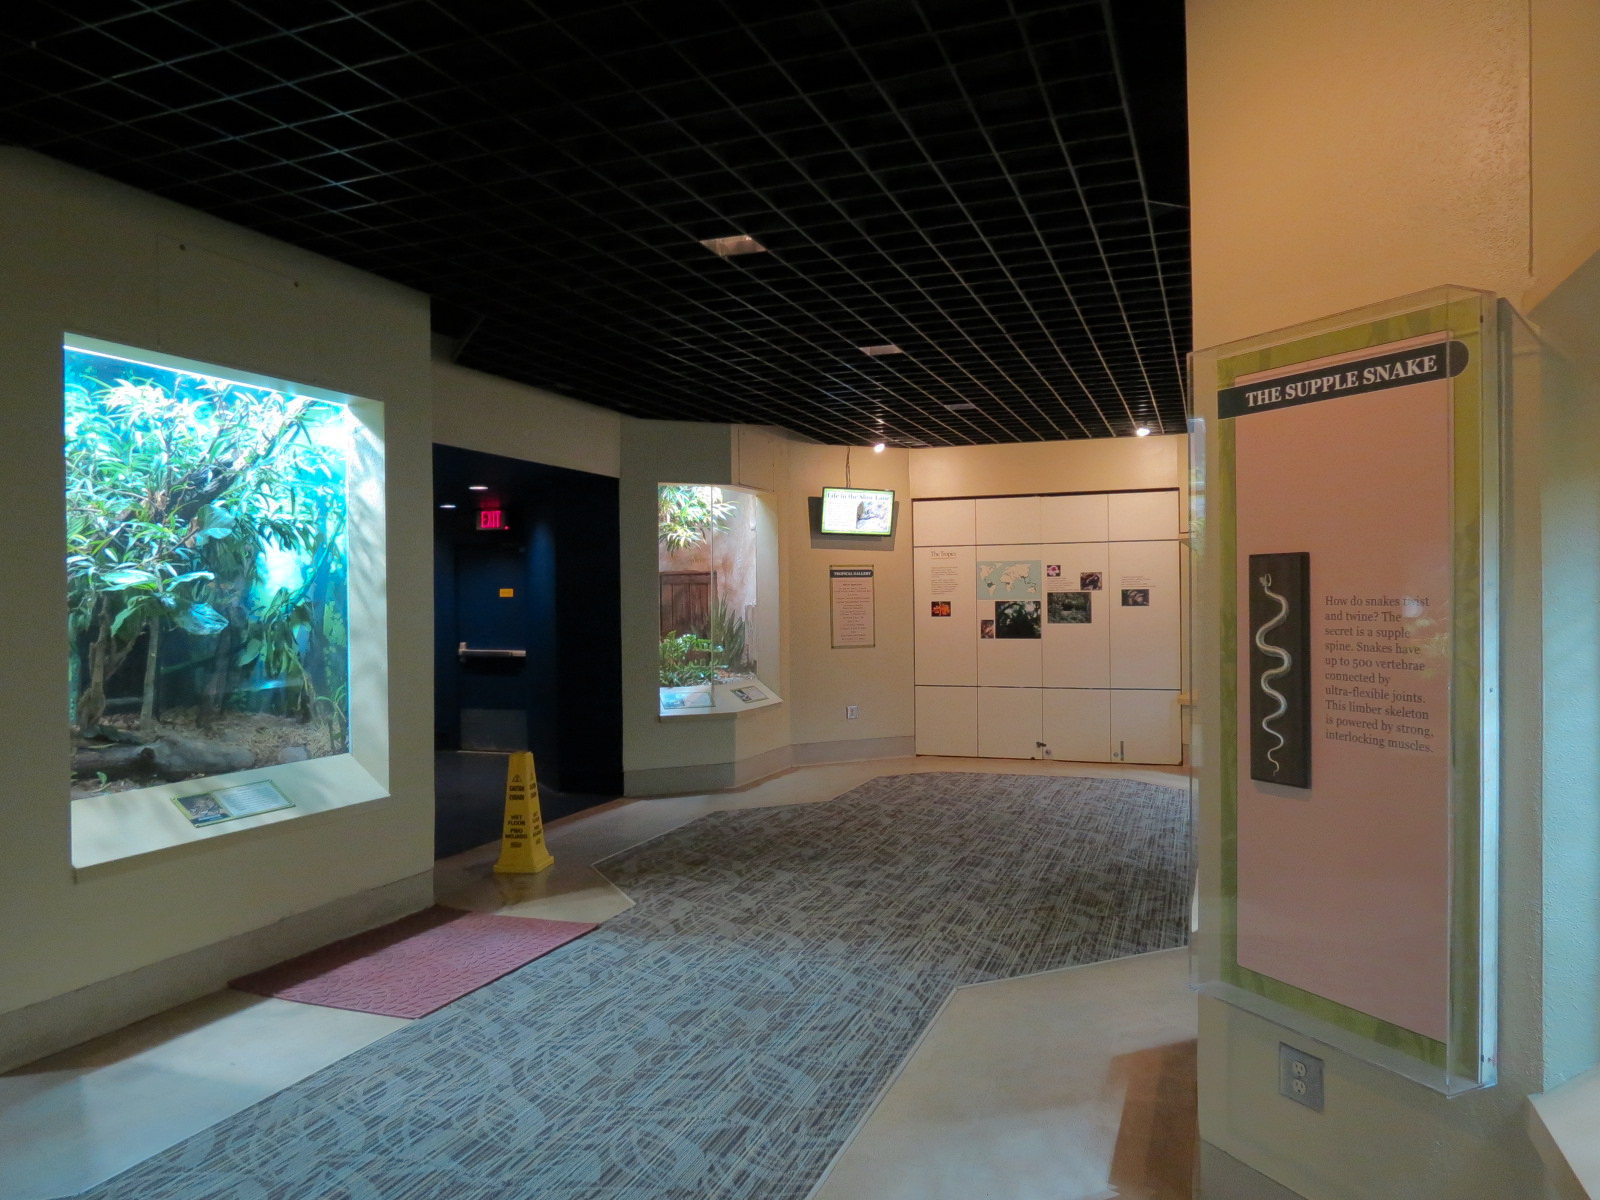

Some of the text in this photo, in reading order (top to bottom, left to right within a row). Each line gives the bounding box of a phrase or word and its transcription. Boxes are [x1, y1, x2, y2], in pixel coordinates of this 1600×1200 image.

[1245, 355, 1437, 407] THE SUPPLE SNAKE
[481, 510, 502, 529] EXIT
[1325, 595, 1349, 606] How
[1350, 595, 1363, 606] do
[1365, 595, 1400, 607] snakes
[1325, 610, 1402, 622] and twine? The
[1325, 626, 1411, 641] secret is a supple
[1325, 640, 1421, 655] spine. Snakes have
[1325, 656, 1425, 671] up to 500 vertebrae
[1325, 672, 1391, 687] connected by
[1325, 685, 1426, 704] ultra-flexible joints.
[1325, 699, 1429, 720] This limber skeleton
[1325, 714, 1434, 739] is powered by strong,
[1325, 729, 1434, 753] interlocking muscles.
